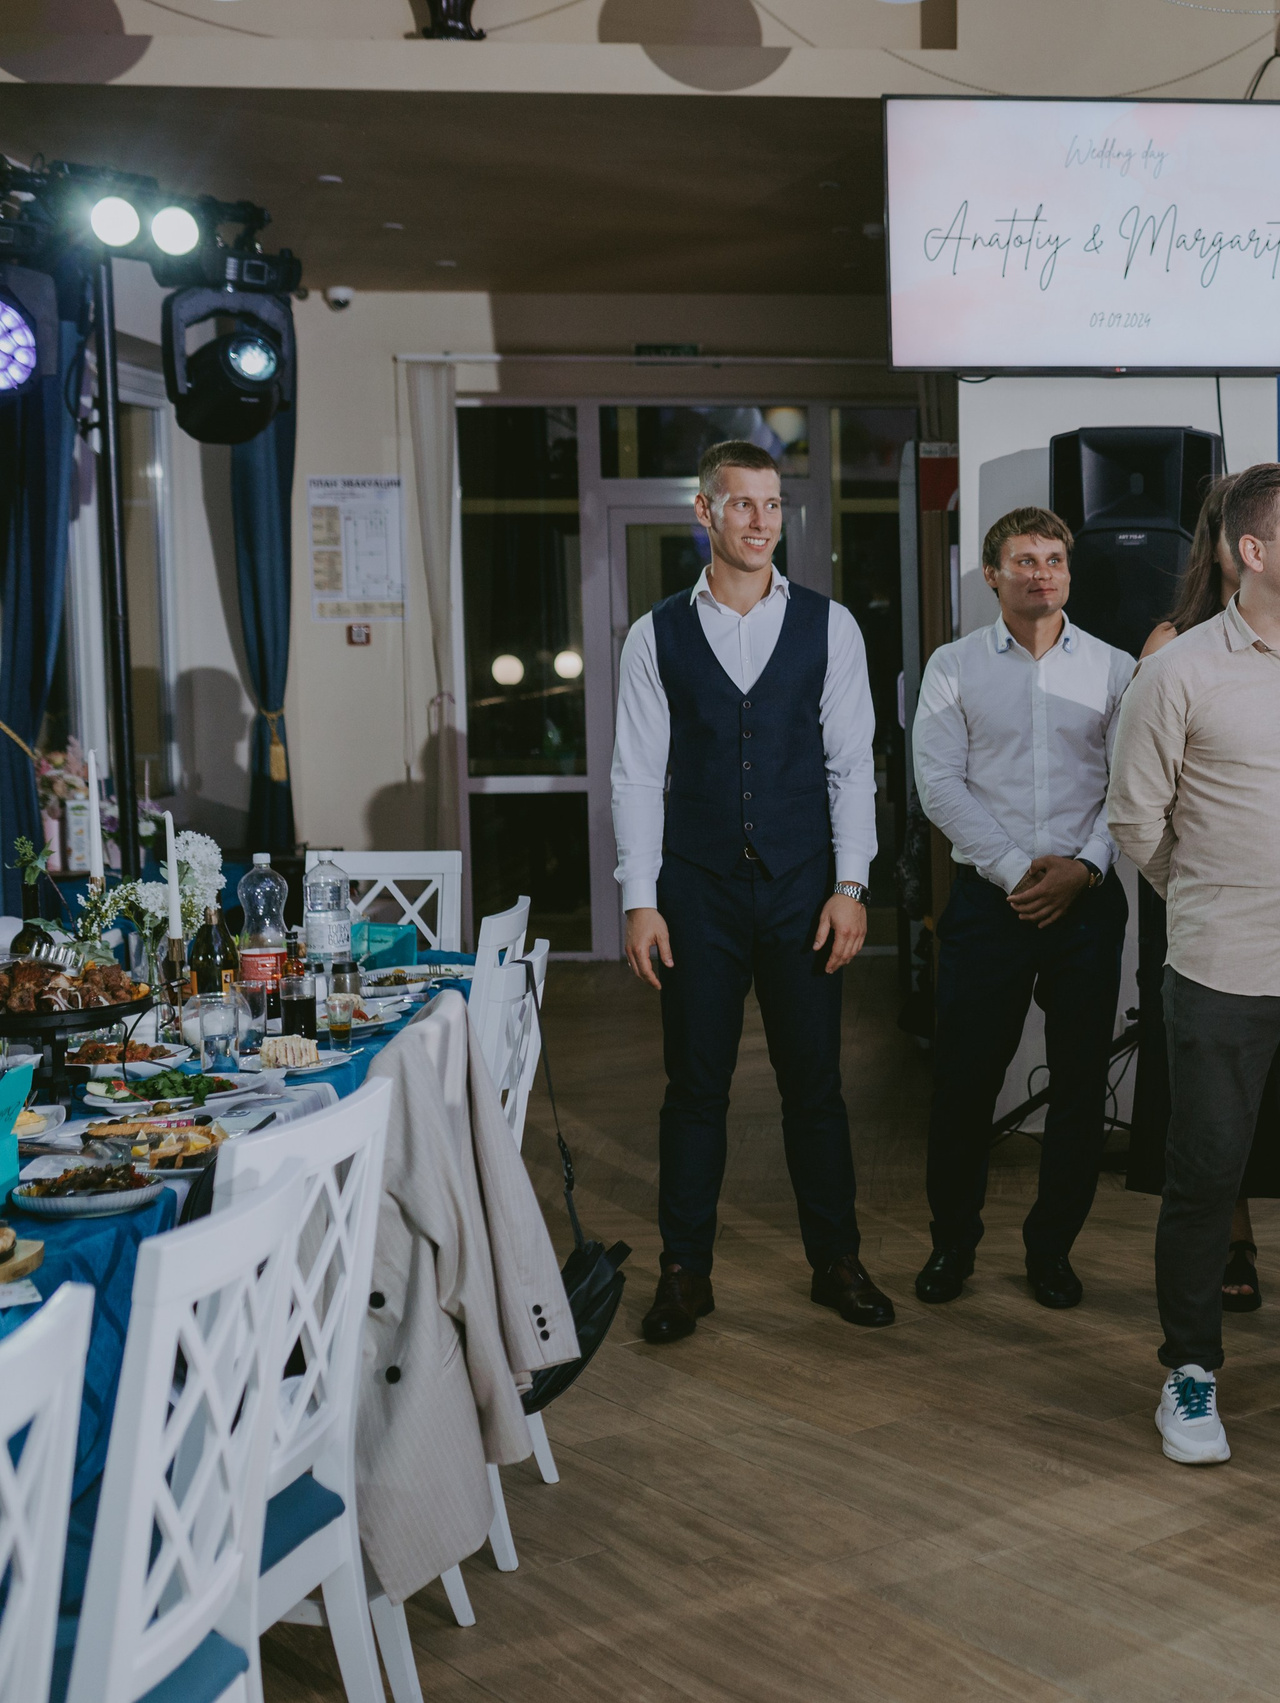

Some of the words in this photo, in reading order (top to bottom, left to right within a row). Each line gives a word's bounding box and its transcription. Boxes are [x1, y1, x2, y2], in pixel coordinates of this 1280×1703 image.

[1065, 135, 1137, 177] Wedding
[1141, 138, 1169, 179] day
[1083, 224, 1104, 254] &
[1089, 312, 1151, 328] 07.09.2024
